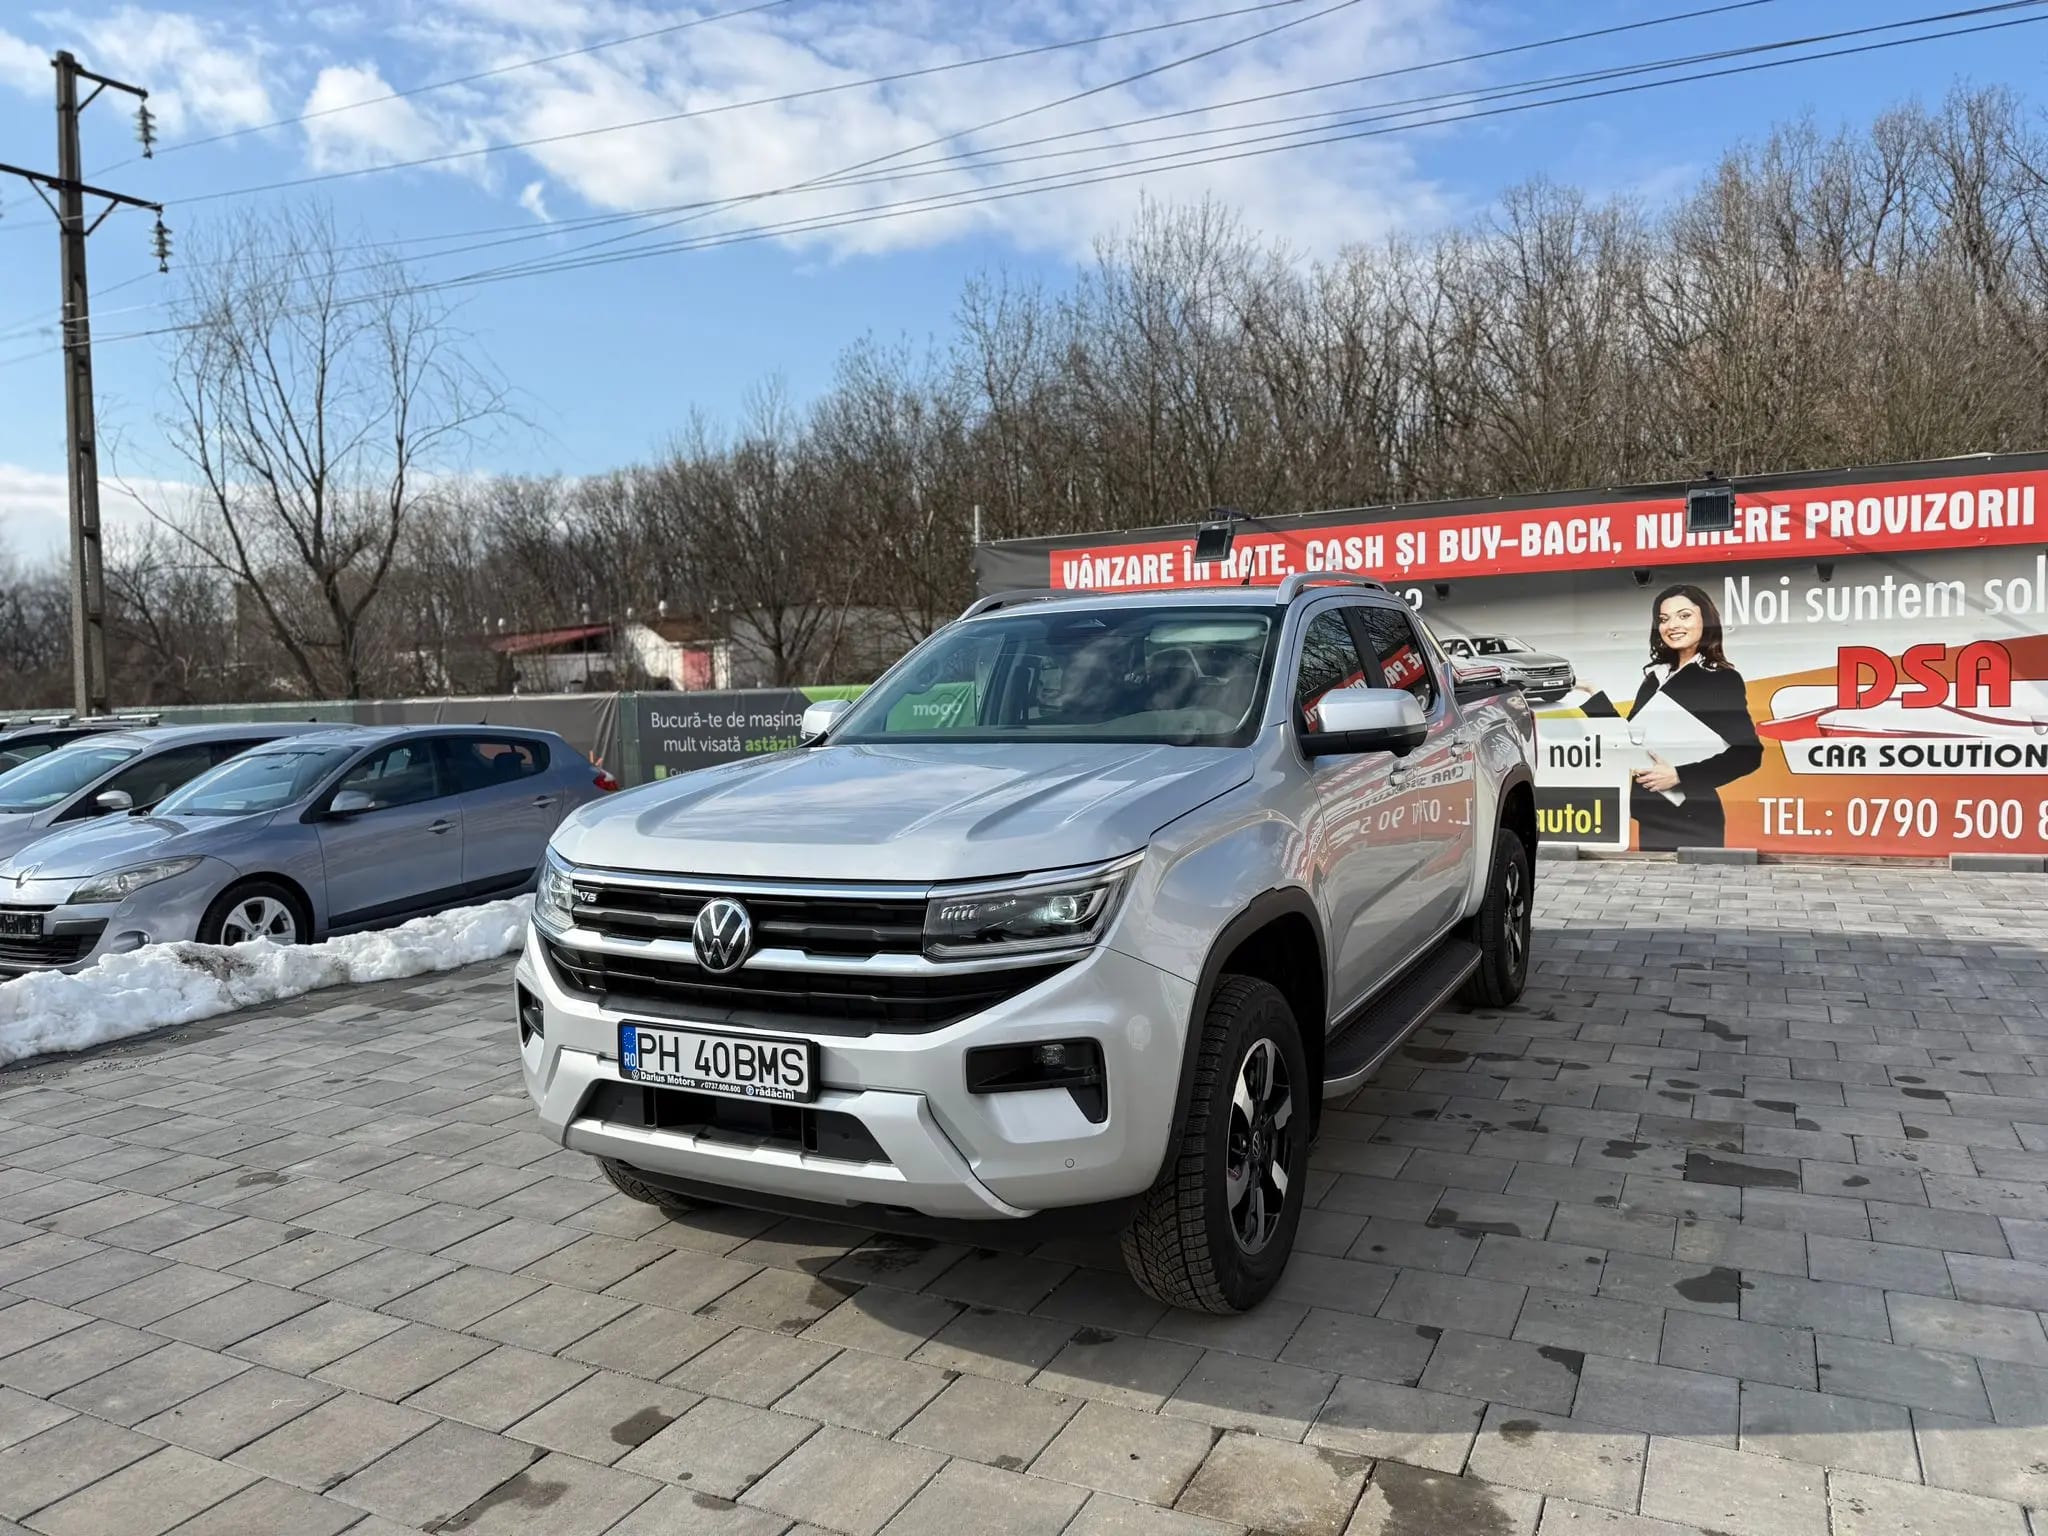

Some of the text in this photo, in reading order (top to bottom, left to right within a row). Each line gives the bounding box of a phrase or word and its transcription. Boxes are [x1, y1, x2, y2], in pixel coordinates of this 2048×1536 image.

[1063, 552, 1174, 590] VÂNZARE
[1306, 535, 1384, 572] CASH
[1395, 531, 1426, 574] ȘI
[1439, 517, 1622, 563] BUY-BACK,
[1805, 486, 2036, 540] PROVIZORII
[1724, 575, 1790, 626] Noi
[1806, 575, 1965, 623] suntem
[1837, 640, 2012, 710] DSA
[651, 710, 803, 730] Bucură-te de mașina
[664, 735, 797, 752] mult visată astăzi!
[1549, 734, 1602, 768] noi!
[1808, 743, 2048, 768] CAR SOLUTION
[1758, 797, 1833, 837] TEL.:
[1847, 797, 1938, 839] 0790
[1953, 798, 2023, 840] 500
[624, 1052, 636, 1067] RO
[637, 1032, 680, 1073] PH
[640, 1071, 666, 1083] Darius
[667, 1074, 696, 1087] Motors
